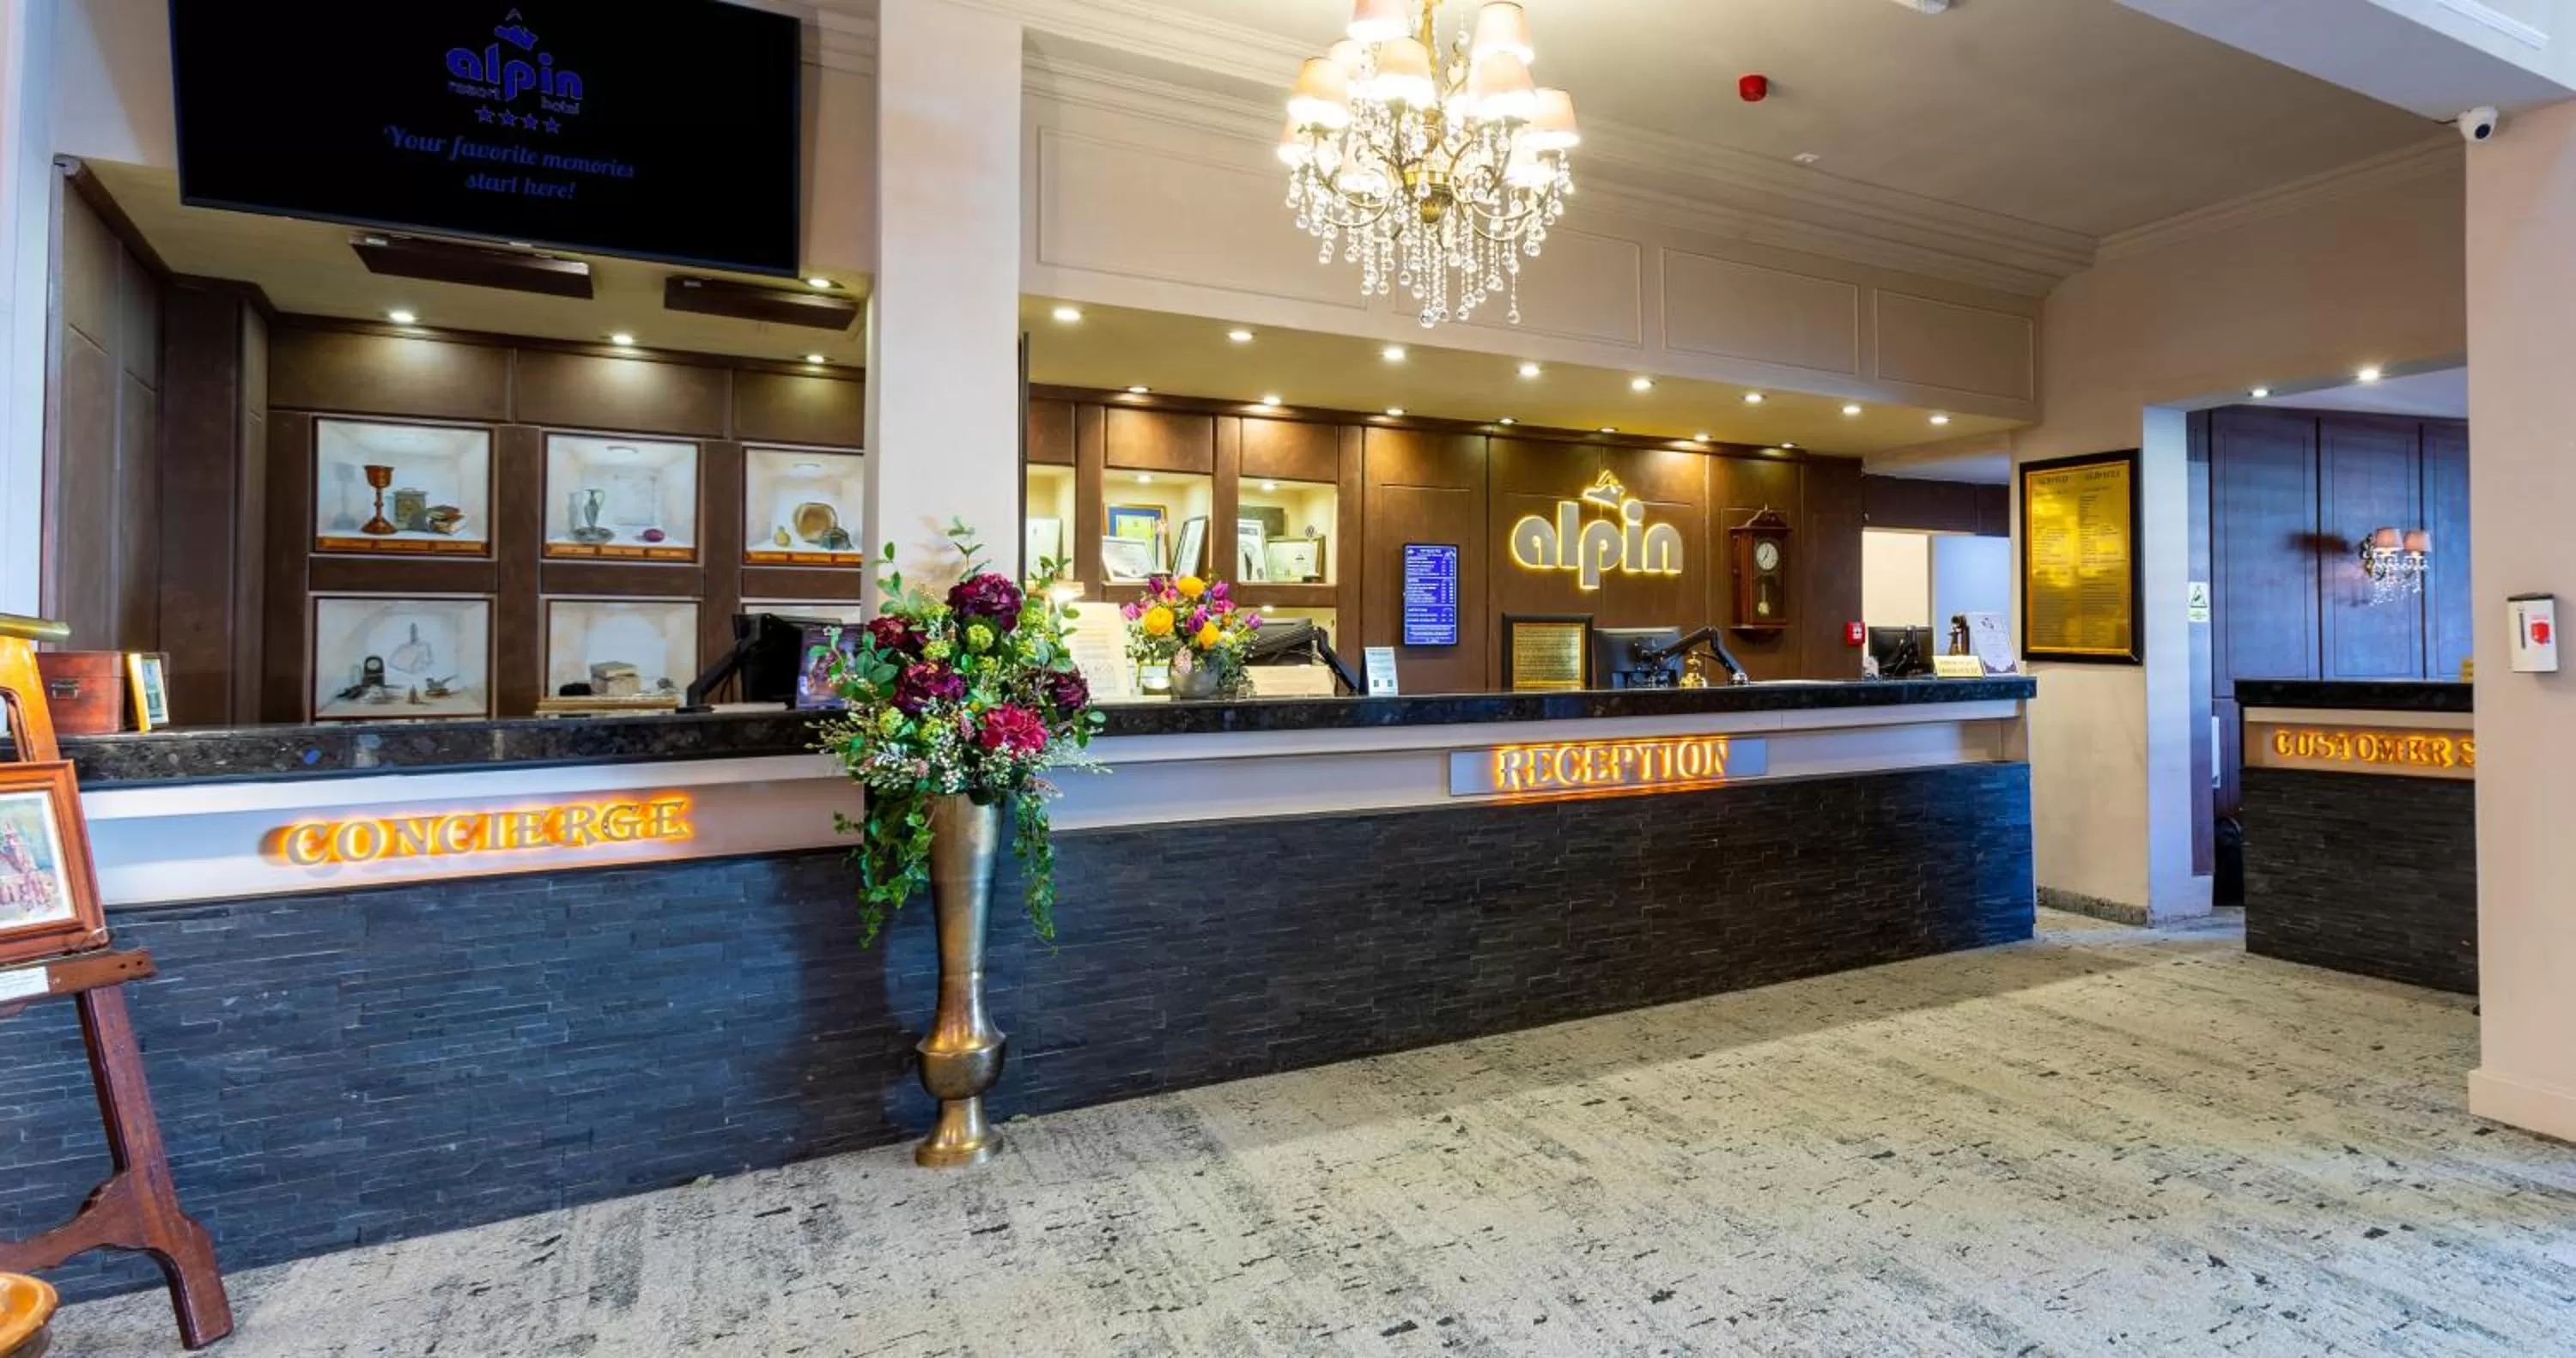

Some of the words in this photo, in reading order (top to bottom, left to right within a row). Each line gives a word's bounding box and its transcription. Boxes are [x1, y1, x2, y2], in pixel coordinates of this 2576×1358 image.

[446, 42, 583, 102] alpin
[541, 96, 580, 115] hotel
[386, 125, 445, 153] Your
[447, 136, 538, 165] favorite
[543, 153, 635, 179] memories
[466, 173, 519, 194] start
[522, 178, 577, 200] here!
[1511, 499, 1684, 590] alpin
[1495, 739, 1729, 791] RECEPTION
[2274, 731, 2454, 768] CUSTOMER
[286, 800, 686, 865] CONCIERGE
